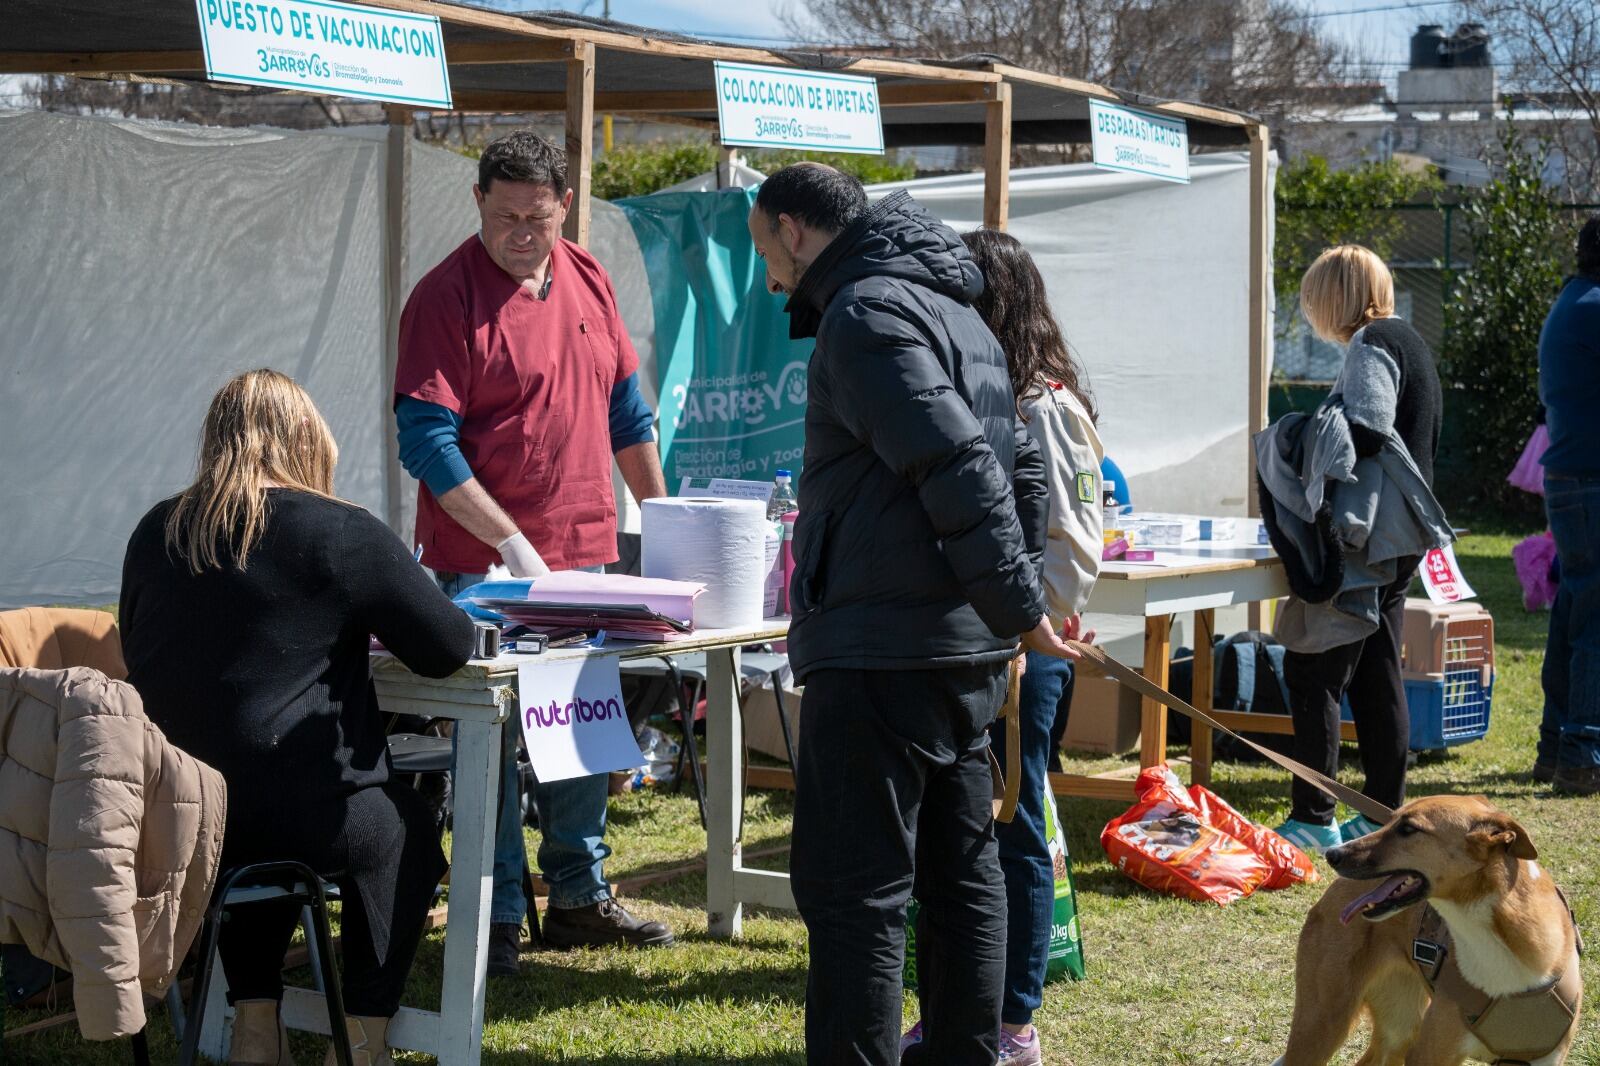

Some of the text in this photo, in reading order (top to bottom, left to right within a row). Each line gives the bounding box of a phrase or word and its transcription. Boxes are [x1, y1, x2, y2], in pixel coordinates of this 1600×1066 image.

[208, 0, 436, 58] PUESTO DE VACUNACION
[723, 77, 875, 115] COLOCACION DE PIPETAS
[1098, 112, 1181, 148] DESPARASITARIOS
[760, 455, 770, 473] y
[526, 697, 622, 730] nutribon
